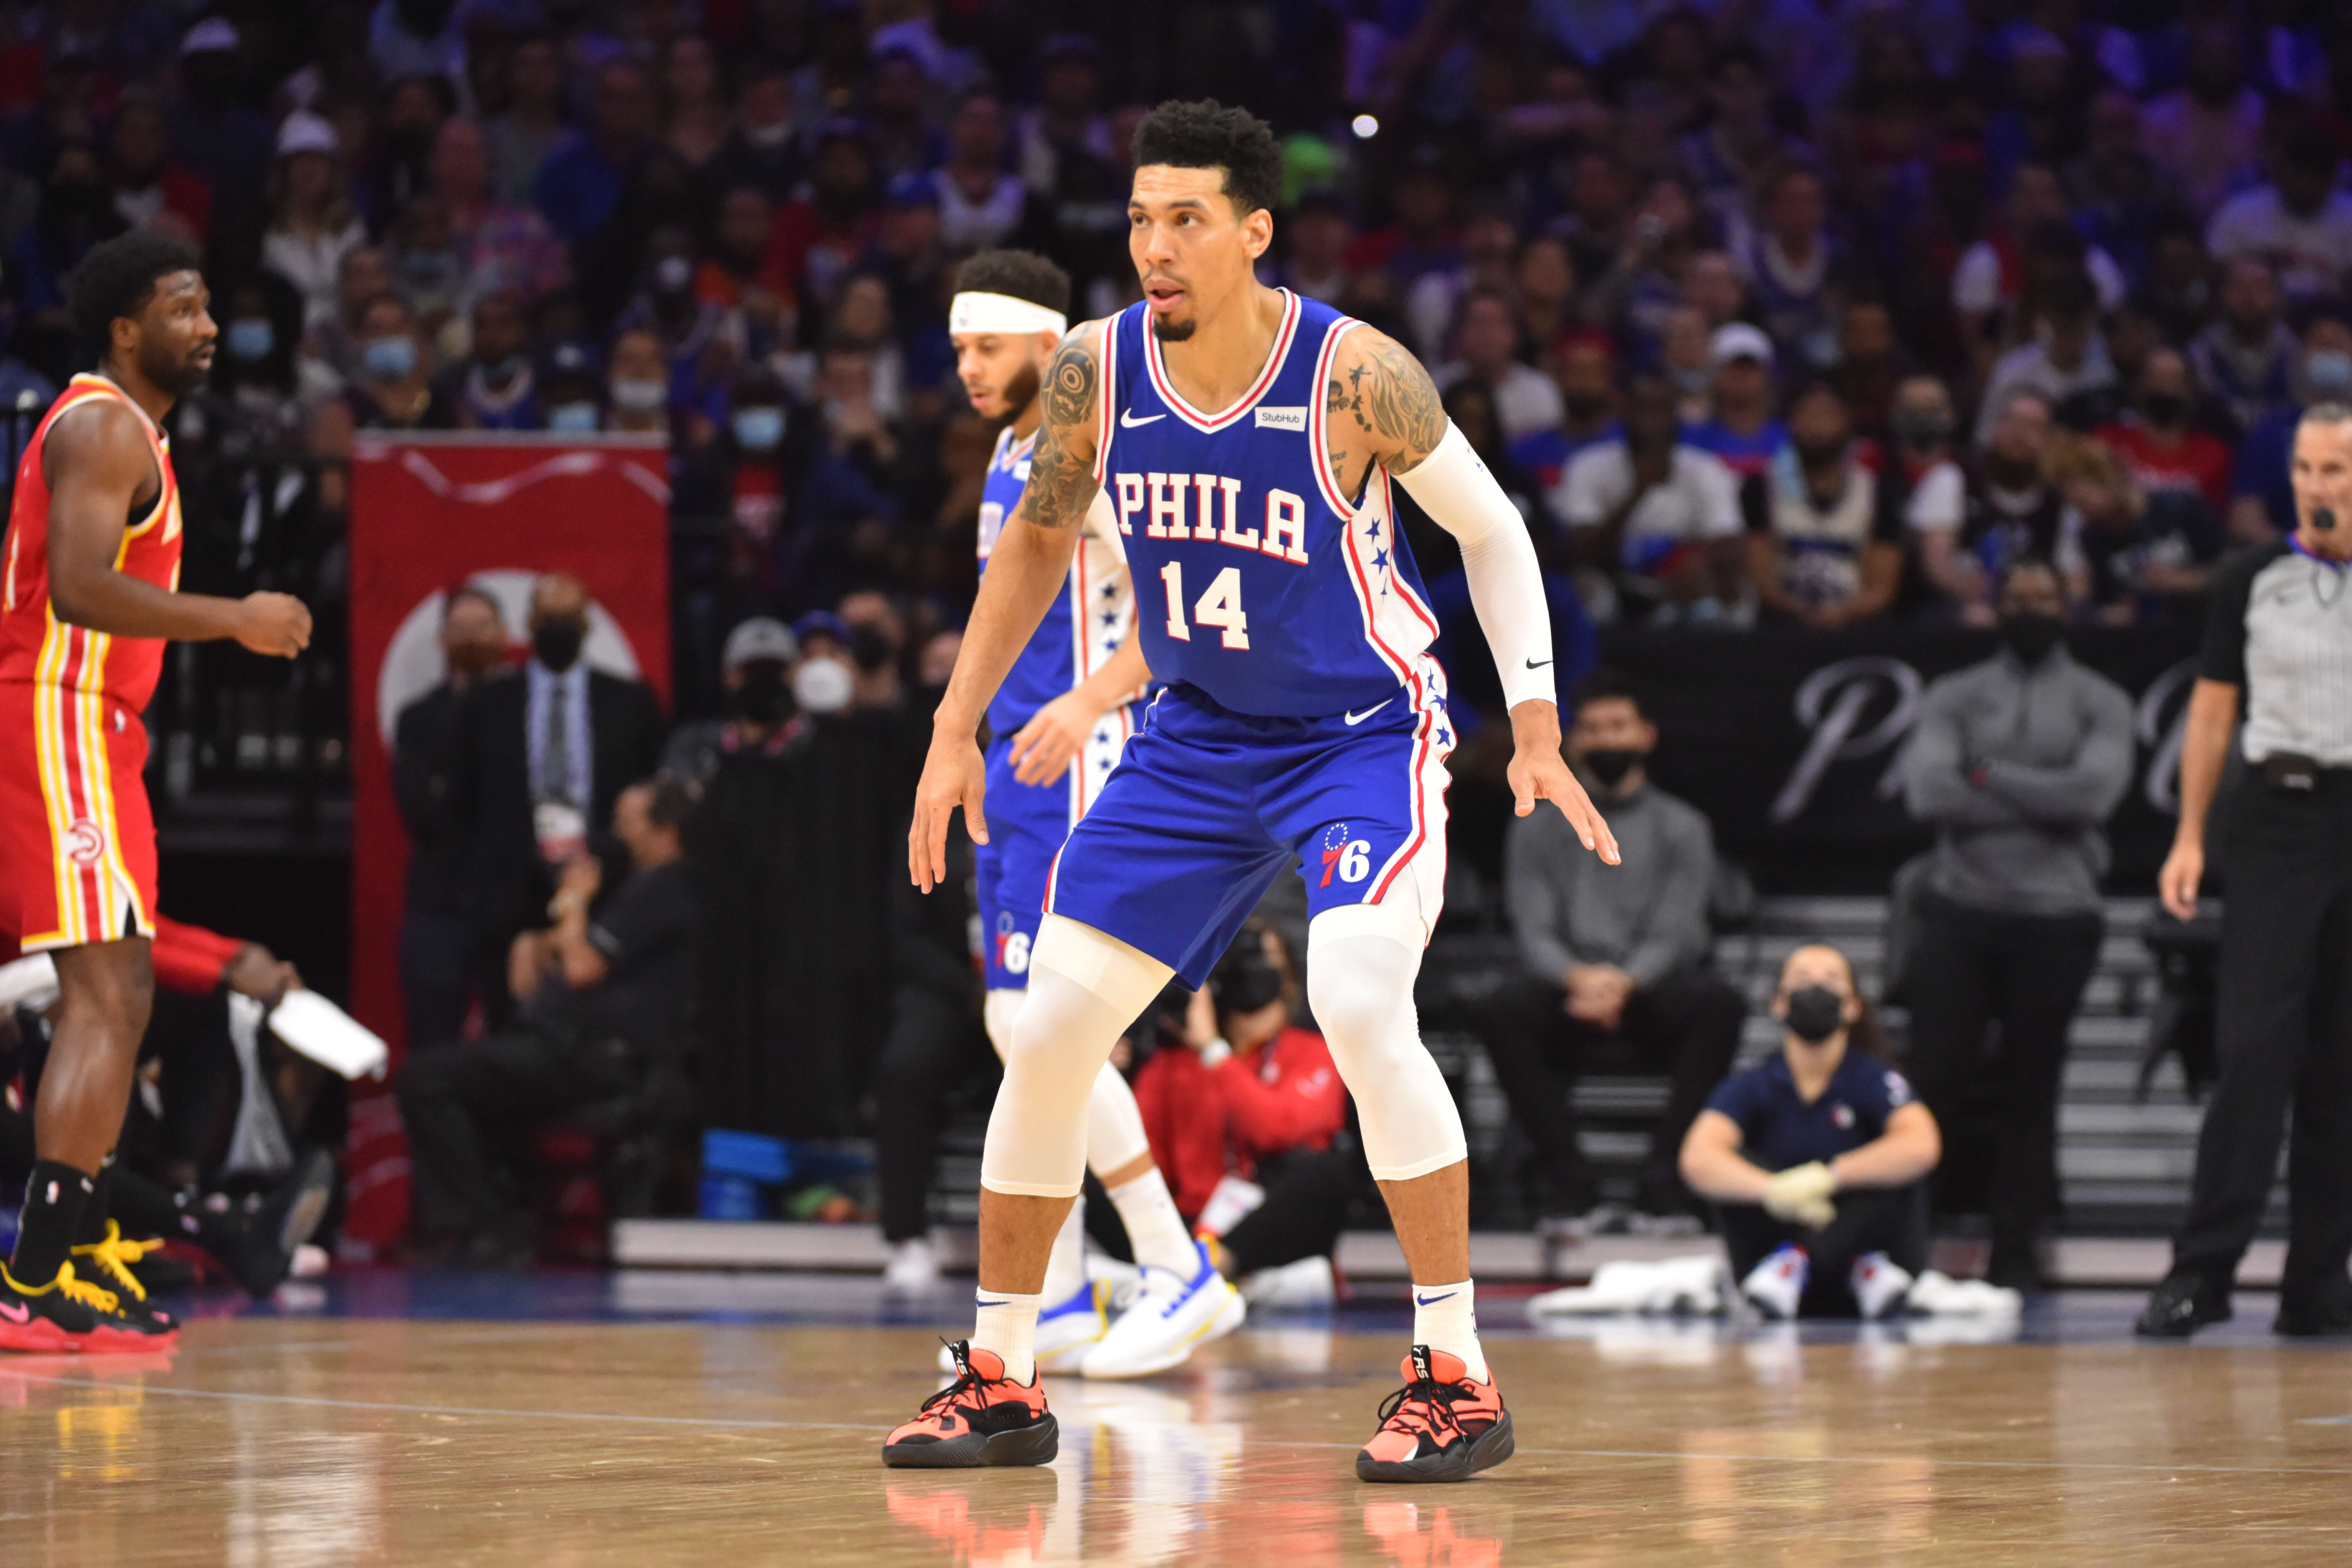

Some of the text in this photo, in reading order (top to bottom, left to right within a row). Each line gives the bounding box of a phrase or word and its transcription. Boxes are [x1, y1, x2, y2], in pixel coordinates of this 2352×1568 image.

[1262, 412, 1300, 423] StubHub
[1114, 472, 1309, 566] PHILA
[1160, 561, 1250, 650] 14
[1320, 839, 1371, 890] 76
